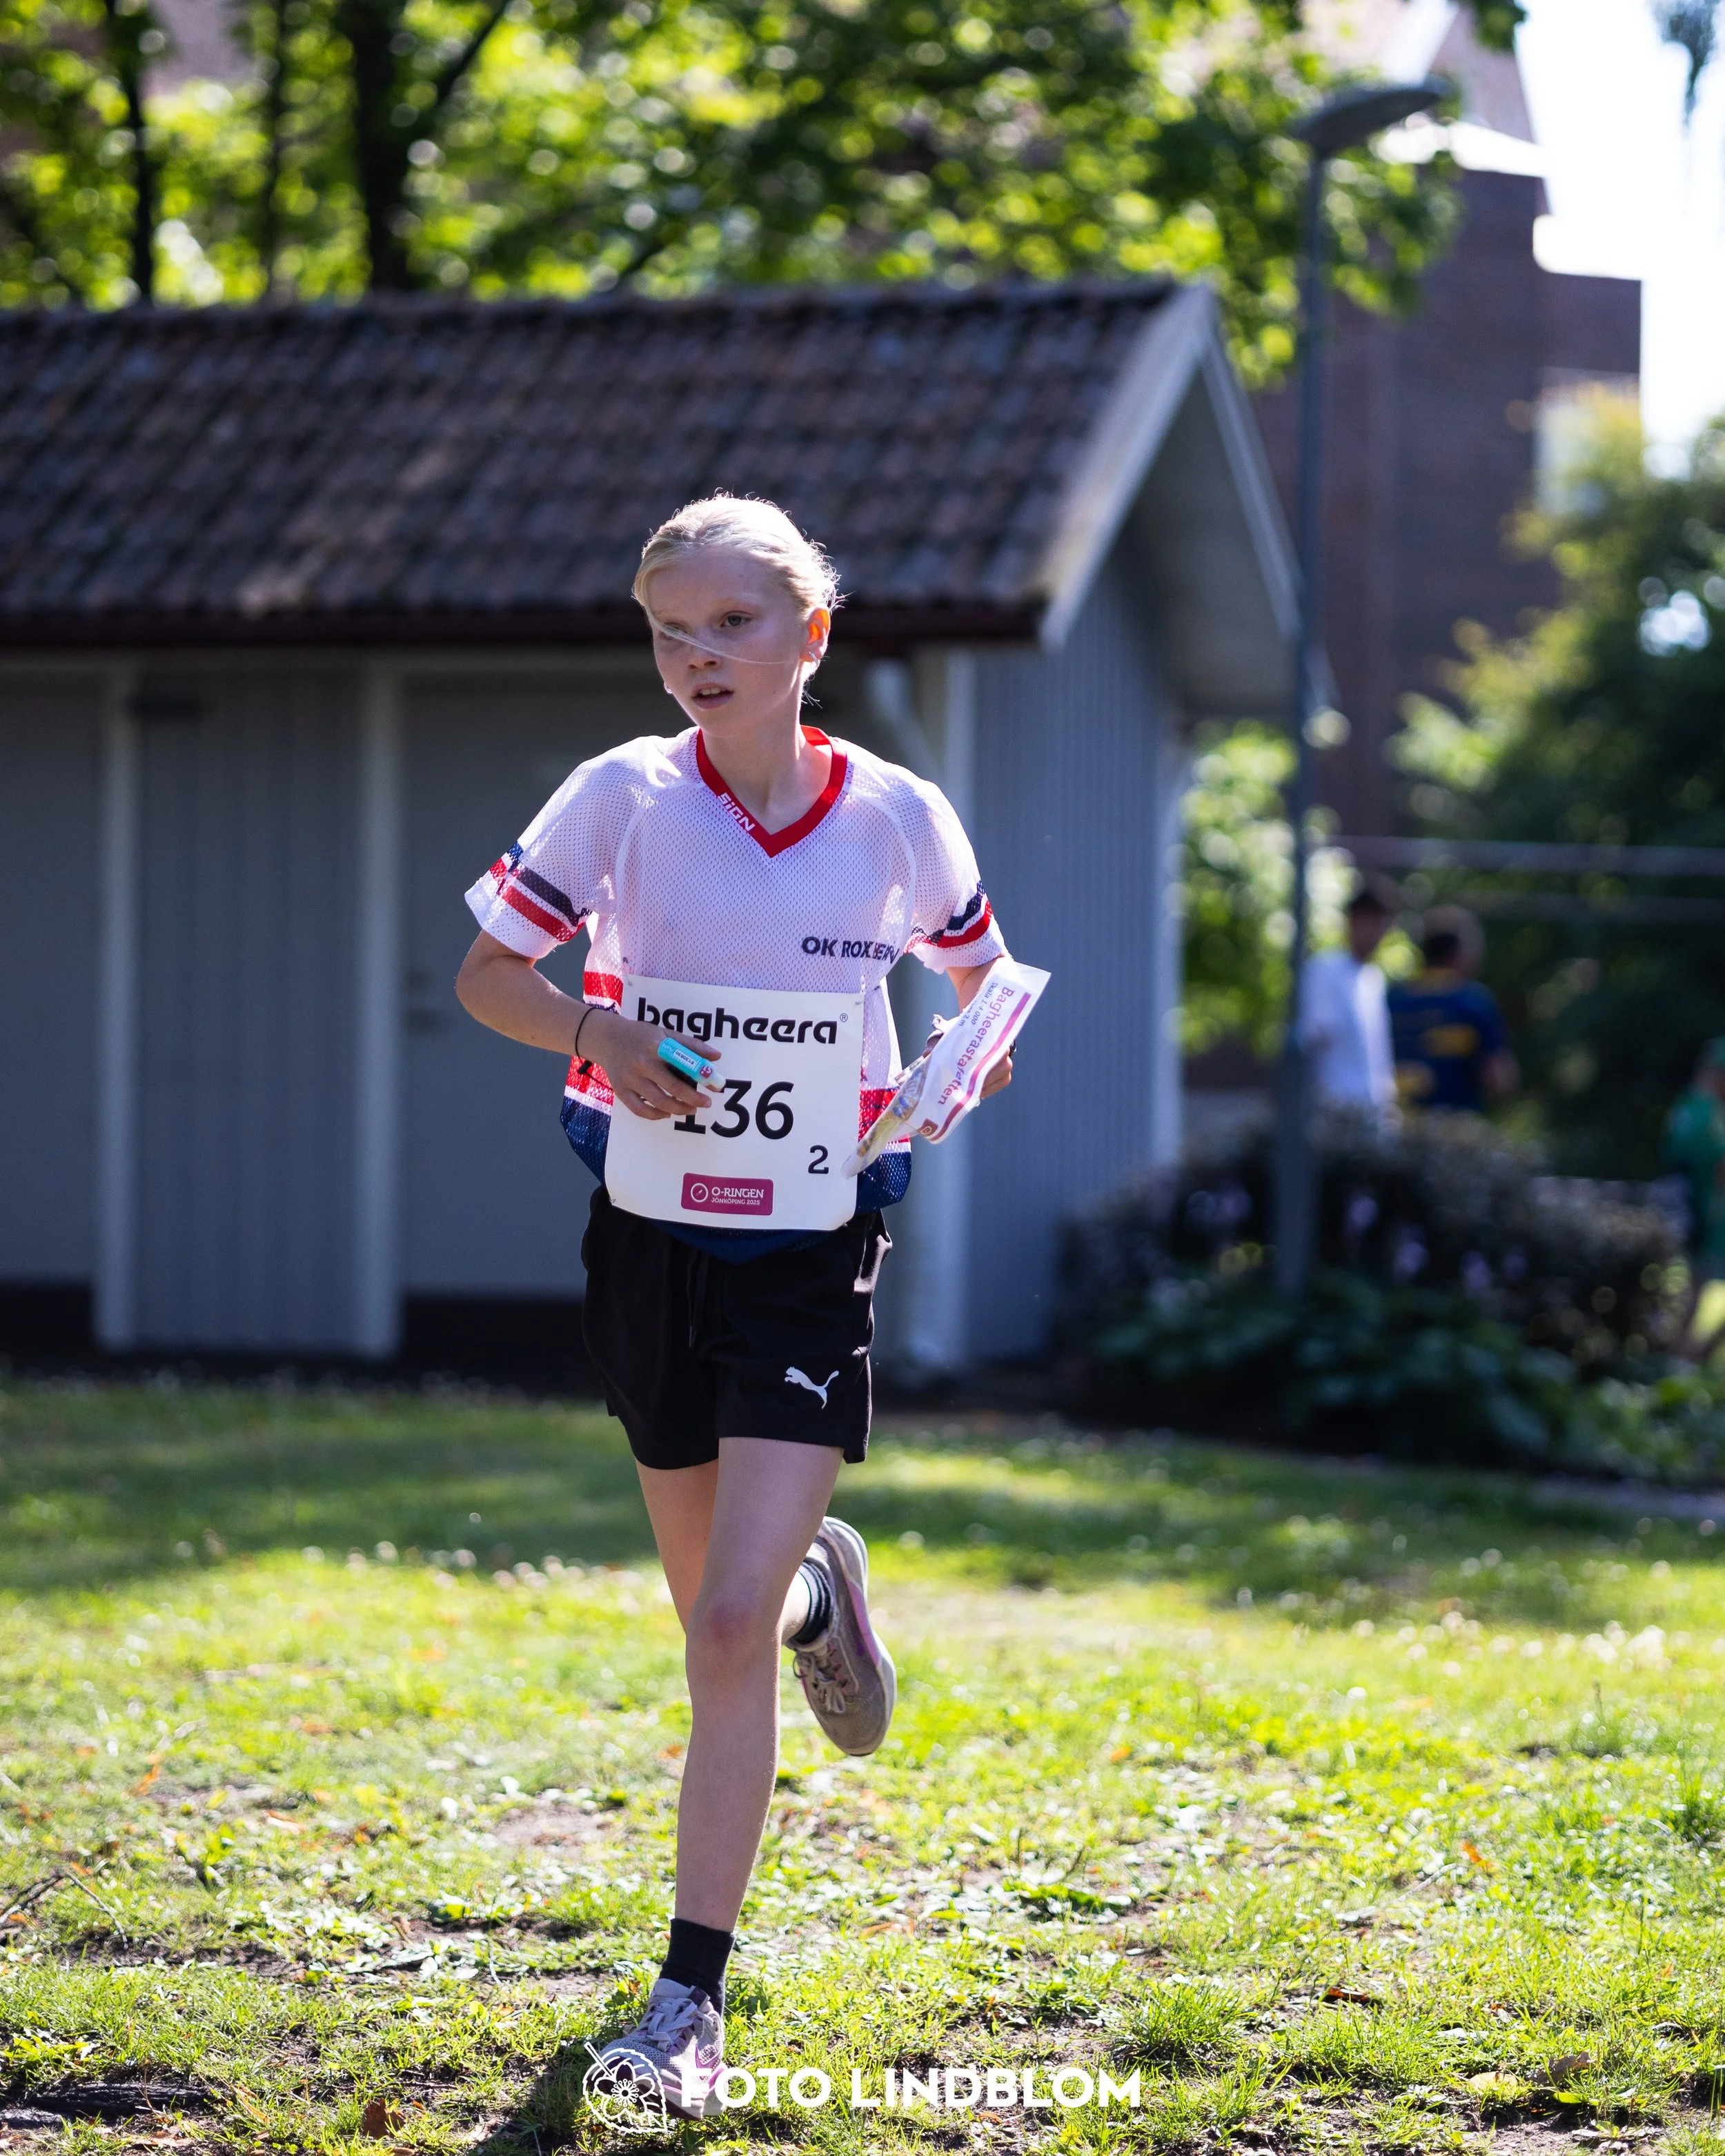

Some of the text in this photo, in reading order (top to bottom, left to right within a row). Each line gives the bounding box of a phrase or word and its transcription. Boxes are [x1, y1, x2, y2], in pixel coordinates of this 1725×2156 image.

[802, 936, 900, 964] OK ROXEN
[985, 981, 998, 998] Skala
[971, 1011, 980, 1025] 000
[938, 986, 1015, 1105] Bagheerastafetten
[808, 1145, 829, 1174] 2
[711, 1187, 764, 1198] O-RINGEN
